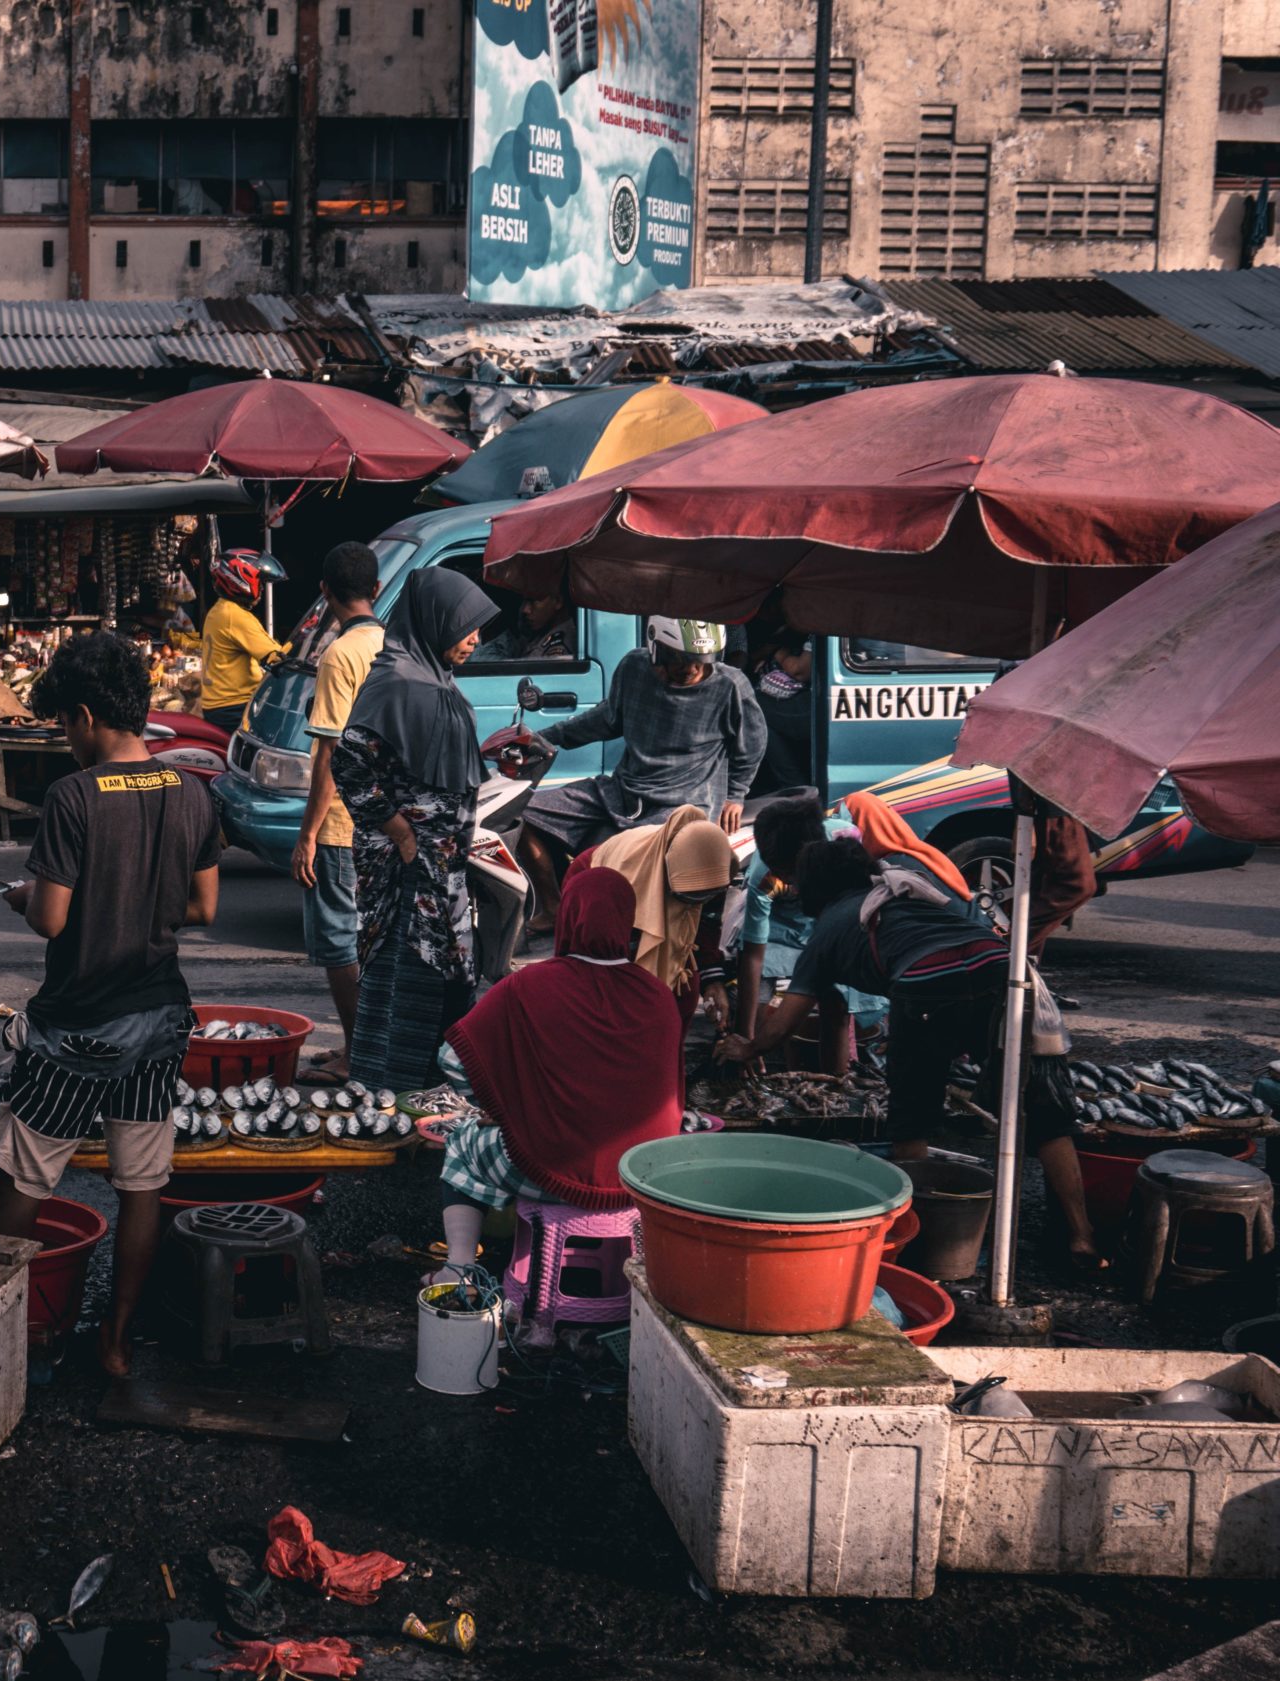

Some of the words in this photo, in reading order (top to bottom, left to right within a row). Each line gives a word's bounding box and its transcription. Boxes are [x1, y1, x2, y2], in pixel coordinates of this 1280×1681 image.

[599, 107, 622, 126] Masak
[624, 117, 642, 134] seng
[643, 118, 667, 137] SUSUT
[528, 125, 562, 151] TANPA
[528, 152, 565, 179] LEHER
[491, 183, 520, 210] ASLI
[646, 197, 690, 224] TERBUKTI
[481, 215, 528, 244] BERSIH
[647, 222, 689, 247] PREMIUM
[653, 249, 682, 266] PRODUCT
[108, 778, 122, 788] AM
